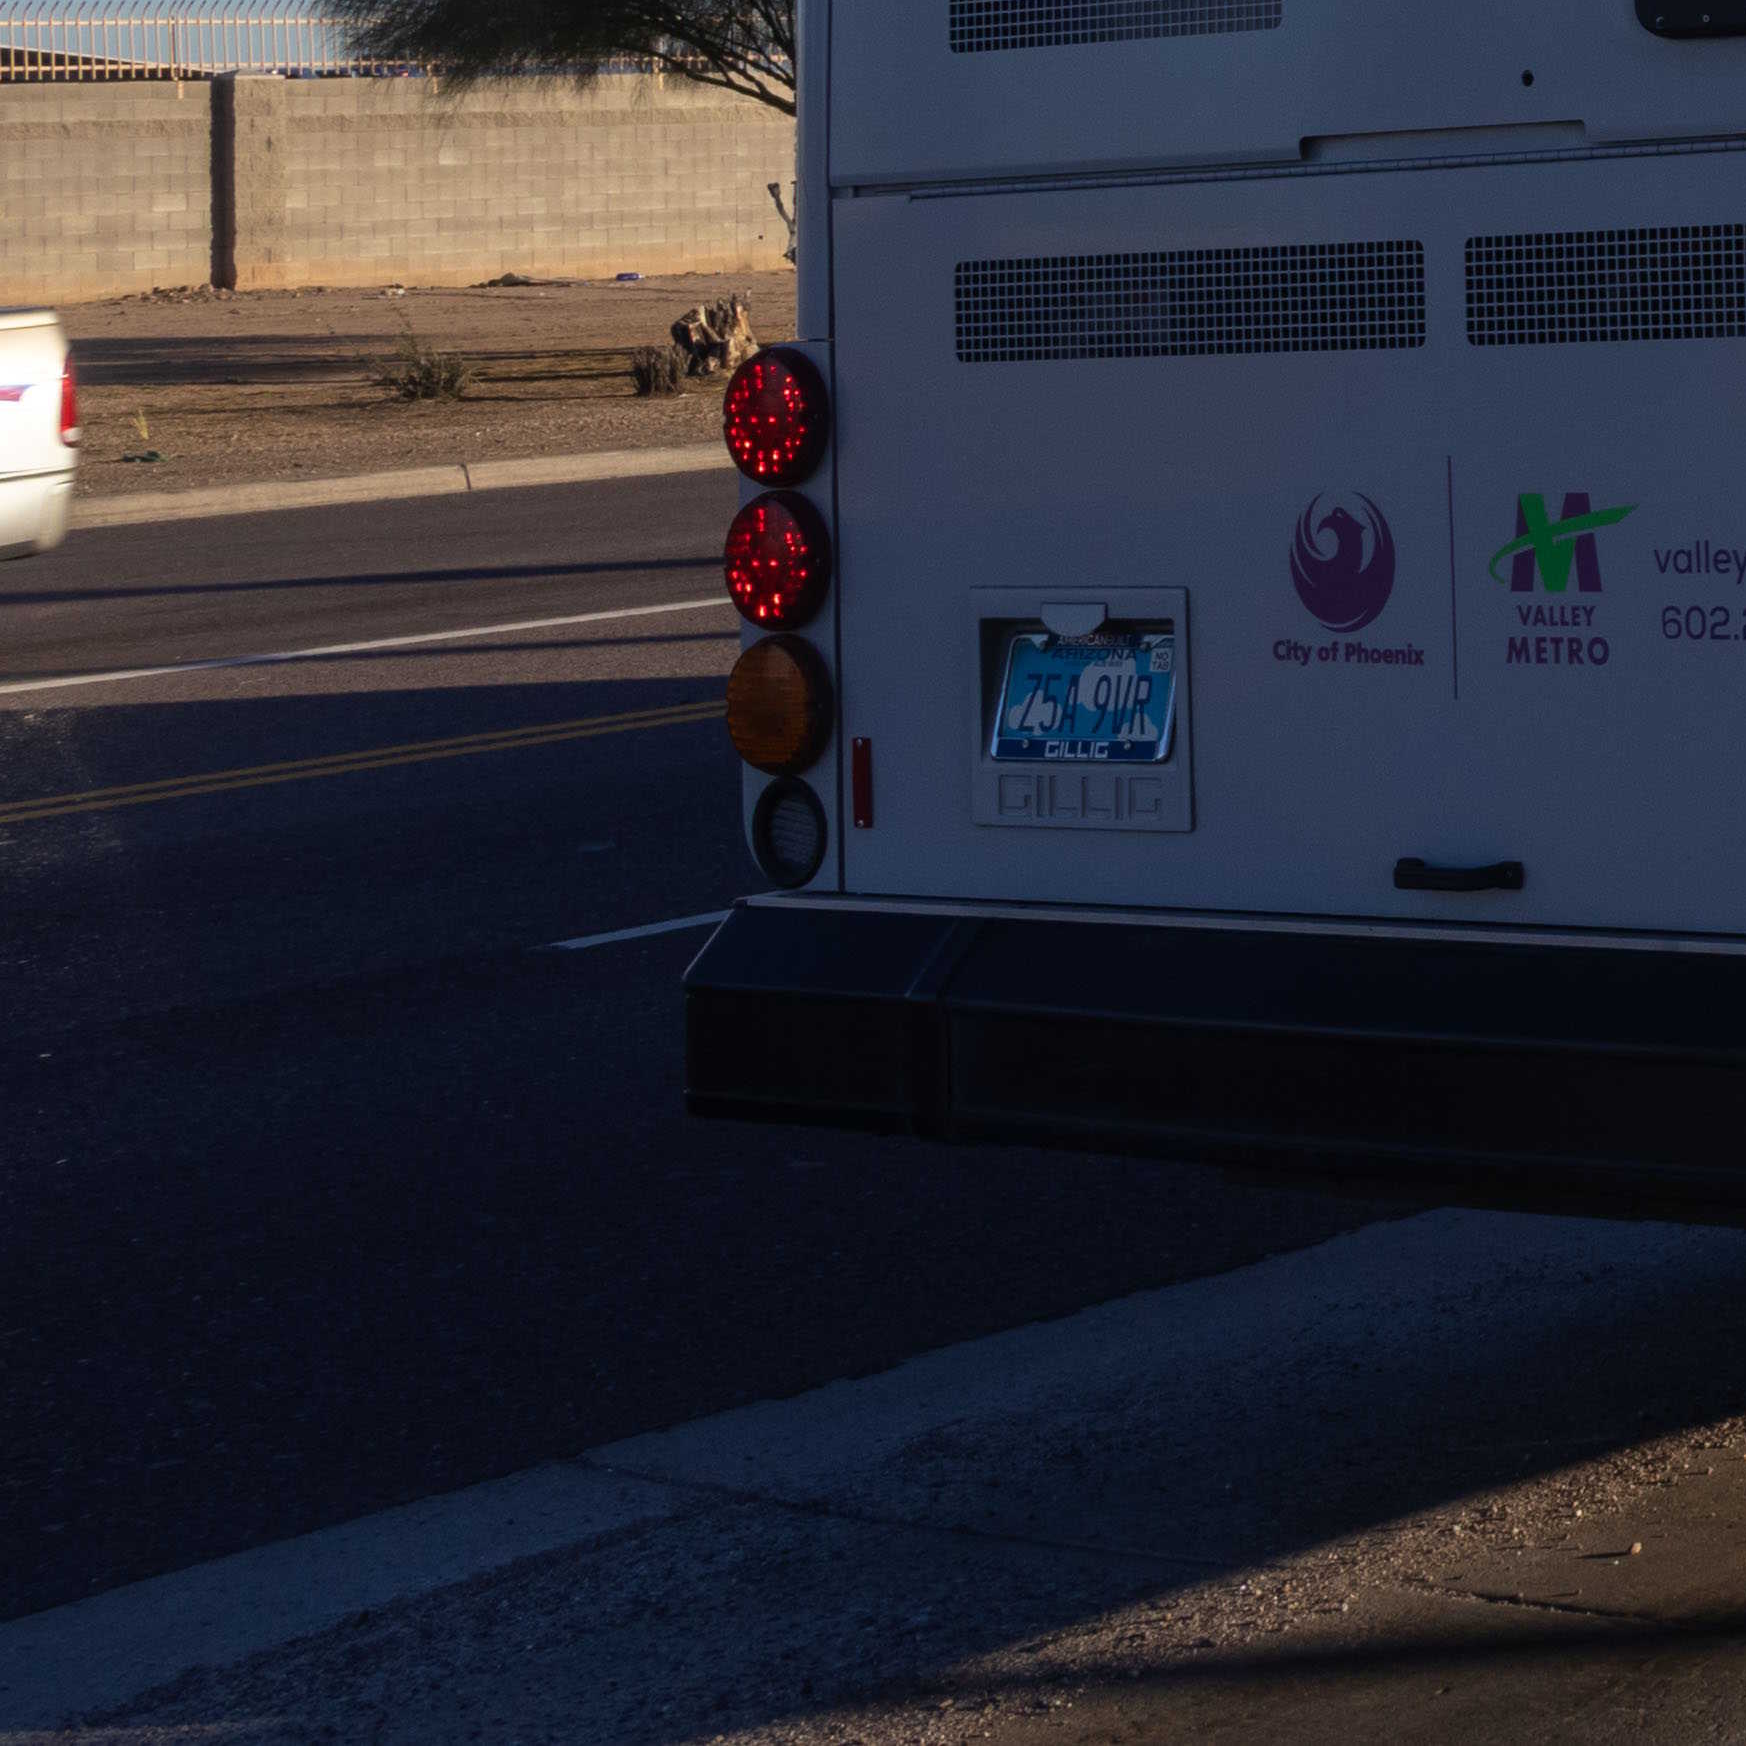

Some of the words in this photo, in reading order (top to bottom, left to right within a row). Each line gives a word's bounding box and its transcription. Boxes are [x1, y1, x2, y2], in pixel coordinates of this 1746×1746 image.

[1518, 604, 1596, 627] VALLEY
[1272, 638, 1312, 666] City
[1317, 639, 1340, 664] of
[1344, 640, 1425, 667] Phoenix
[1506, 636, 1610, 666] METRO
[1044, 740, 1110, 759] GILLIG
[999, 774, 1161, 821] GILLIG
